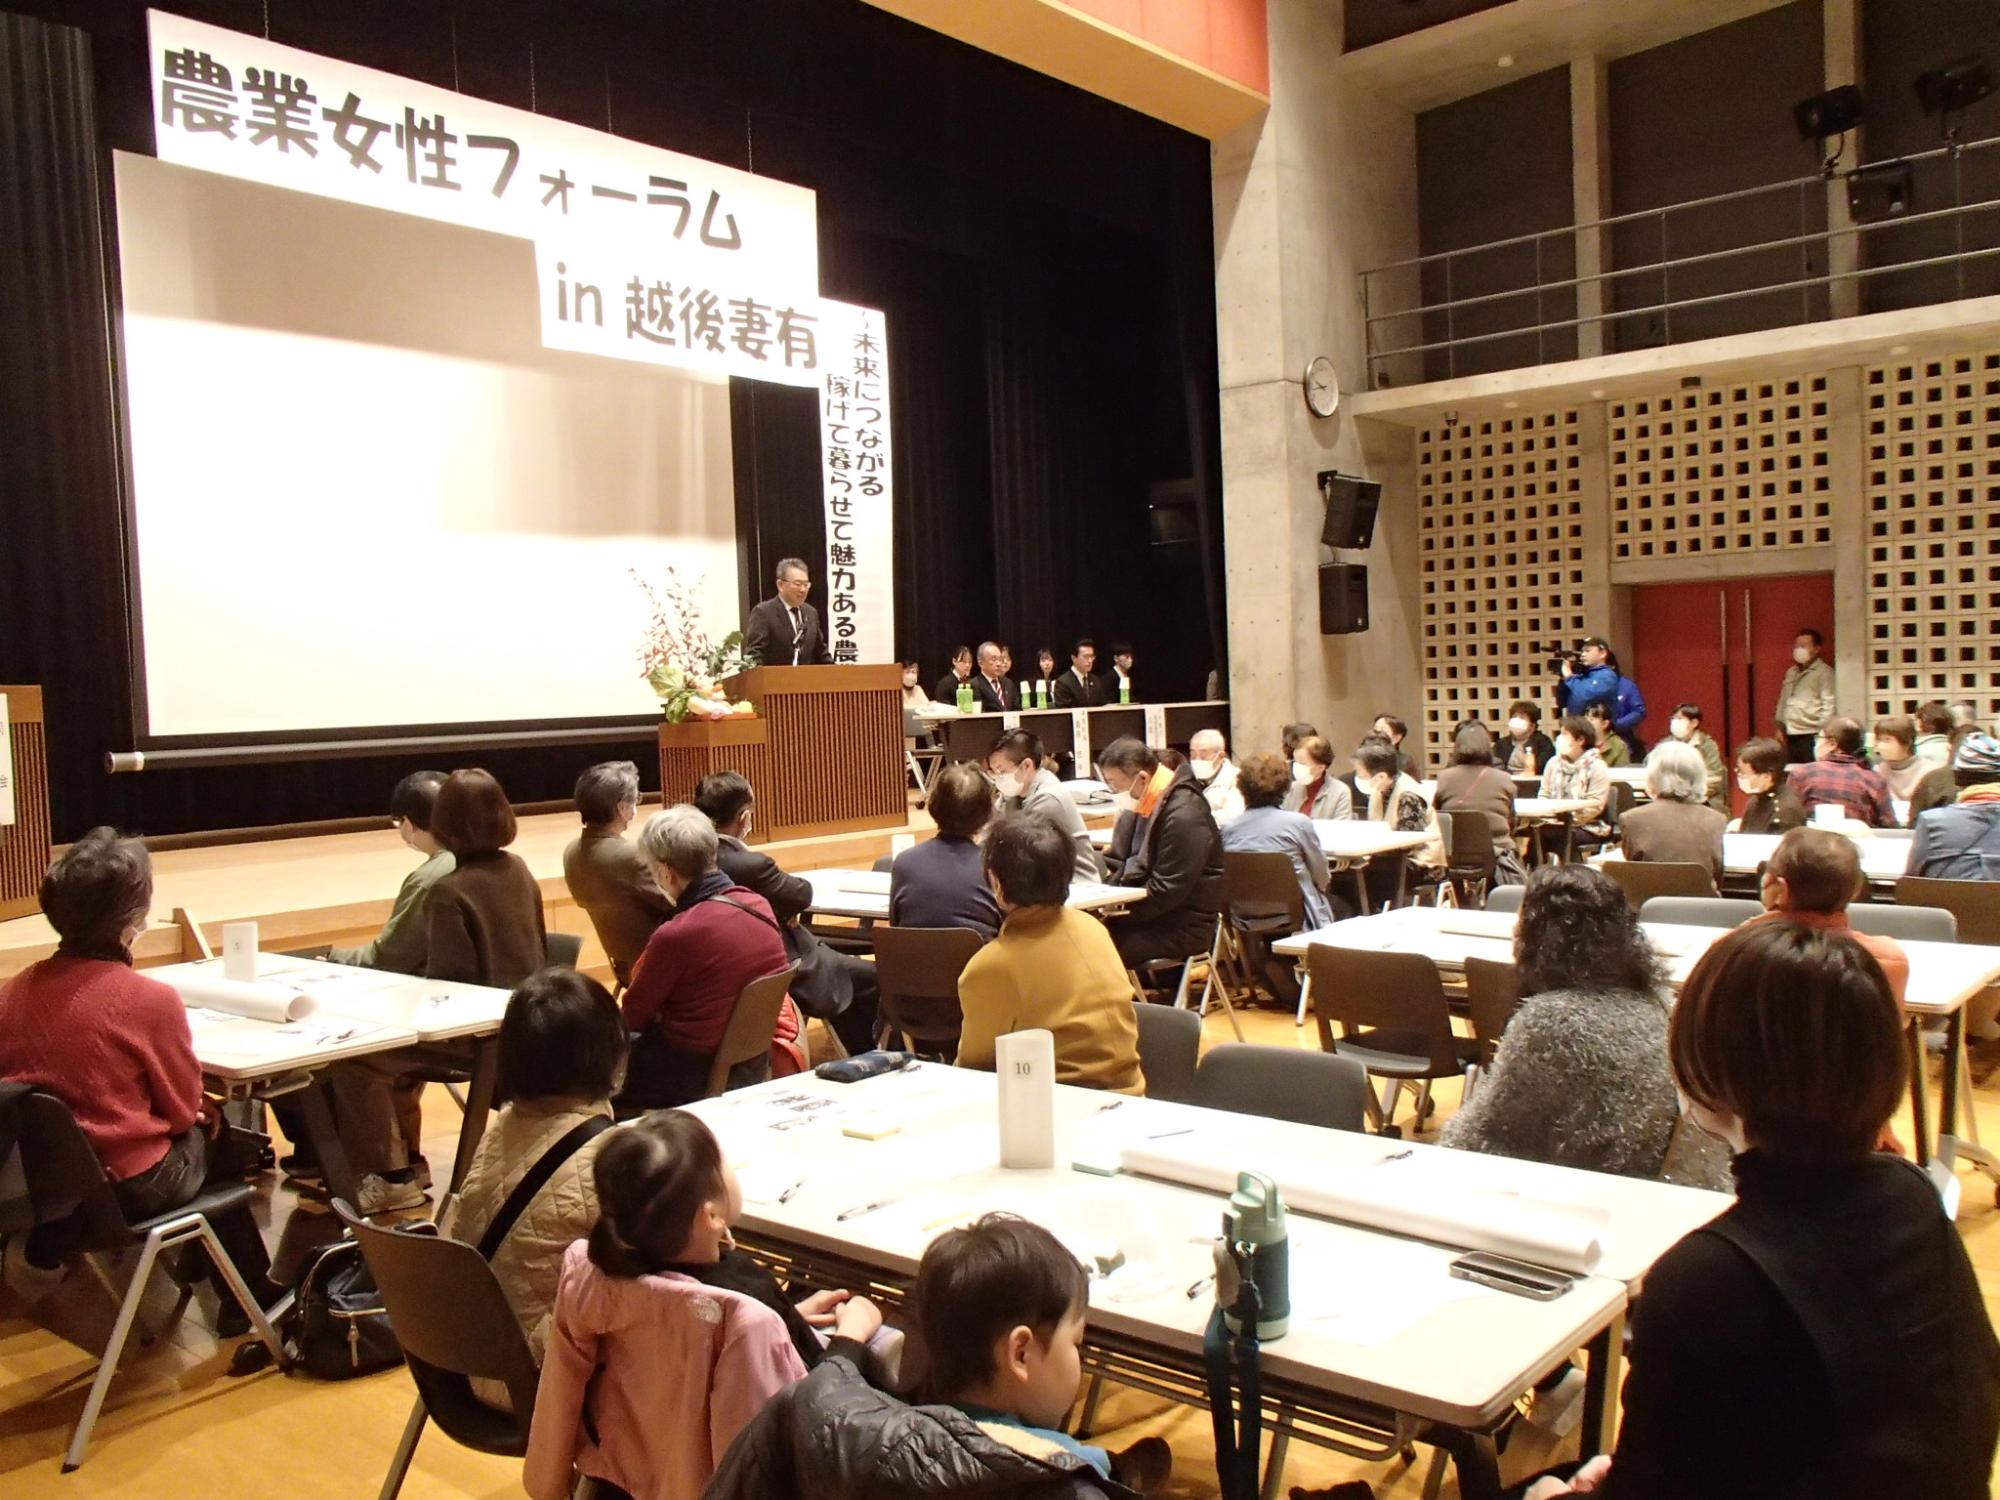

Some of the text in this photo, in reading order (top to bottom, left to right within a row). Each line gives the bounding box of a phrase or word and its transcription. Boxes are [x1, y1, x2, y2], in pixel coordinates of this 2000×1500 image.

[161, 48, 742, 250] 農業女性フォーラム
[557, 262, 819, 369] in 越後妻有
[826, 372, 859, 665] 稼げて暮らせて魅力ある農
[1015, 1062, 1031, 1075] 10
